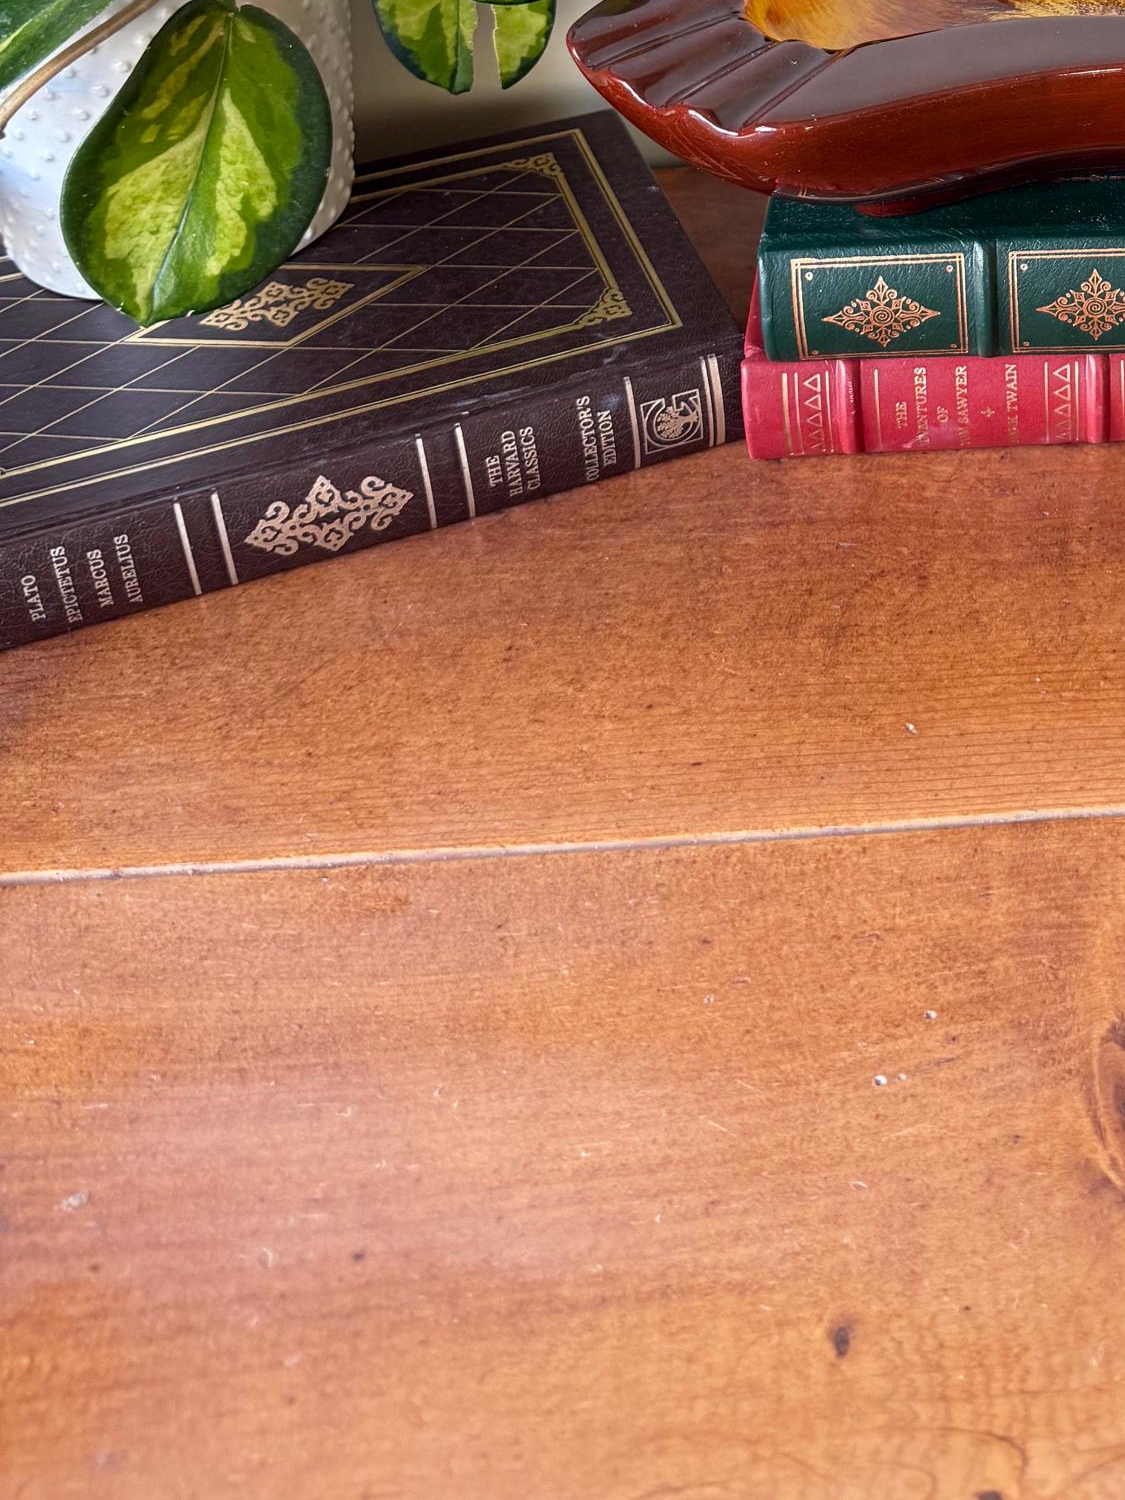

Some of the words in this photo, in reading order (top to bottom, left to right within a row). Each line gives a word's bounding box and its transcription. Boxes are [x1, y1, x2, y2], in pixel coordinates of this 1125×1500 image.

[937, 406, 949, 423] OF
[955, 365, 969, 423] SAWYER
[1005, 364, 1018, 412] TWAIN
[501, 430, 523, 497] HARVARD
[519, 426, 541, 490] CLASSICS
[576, 395, 600, 481] COLLECTOR'S
[597, 409, 617, 467] EDITION
[485, 454, 503, 487] THE
[50, 545, 83, 623] EPICTETUS
[86, 549, 114, 608] MARCUS
[113, 533, 143, 602] AURELIUS
[20, 574, 46, 622] PLATO
